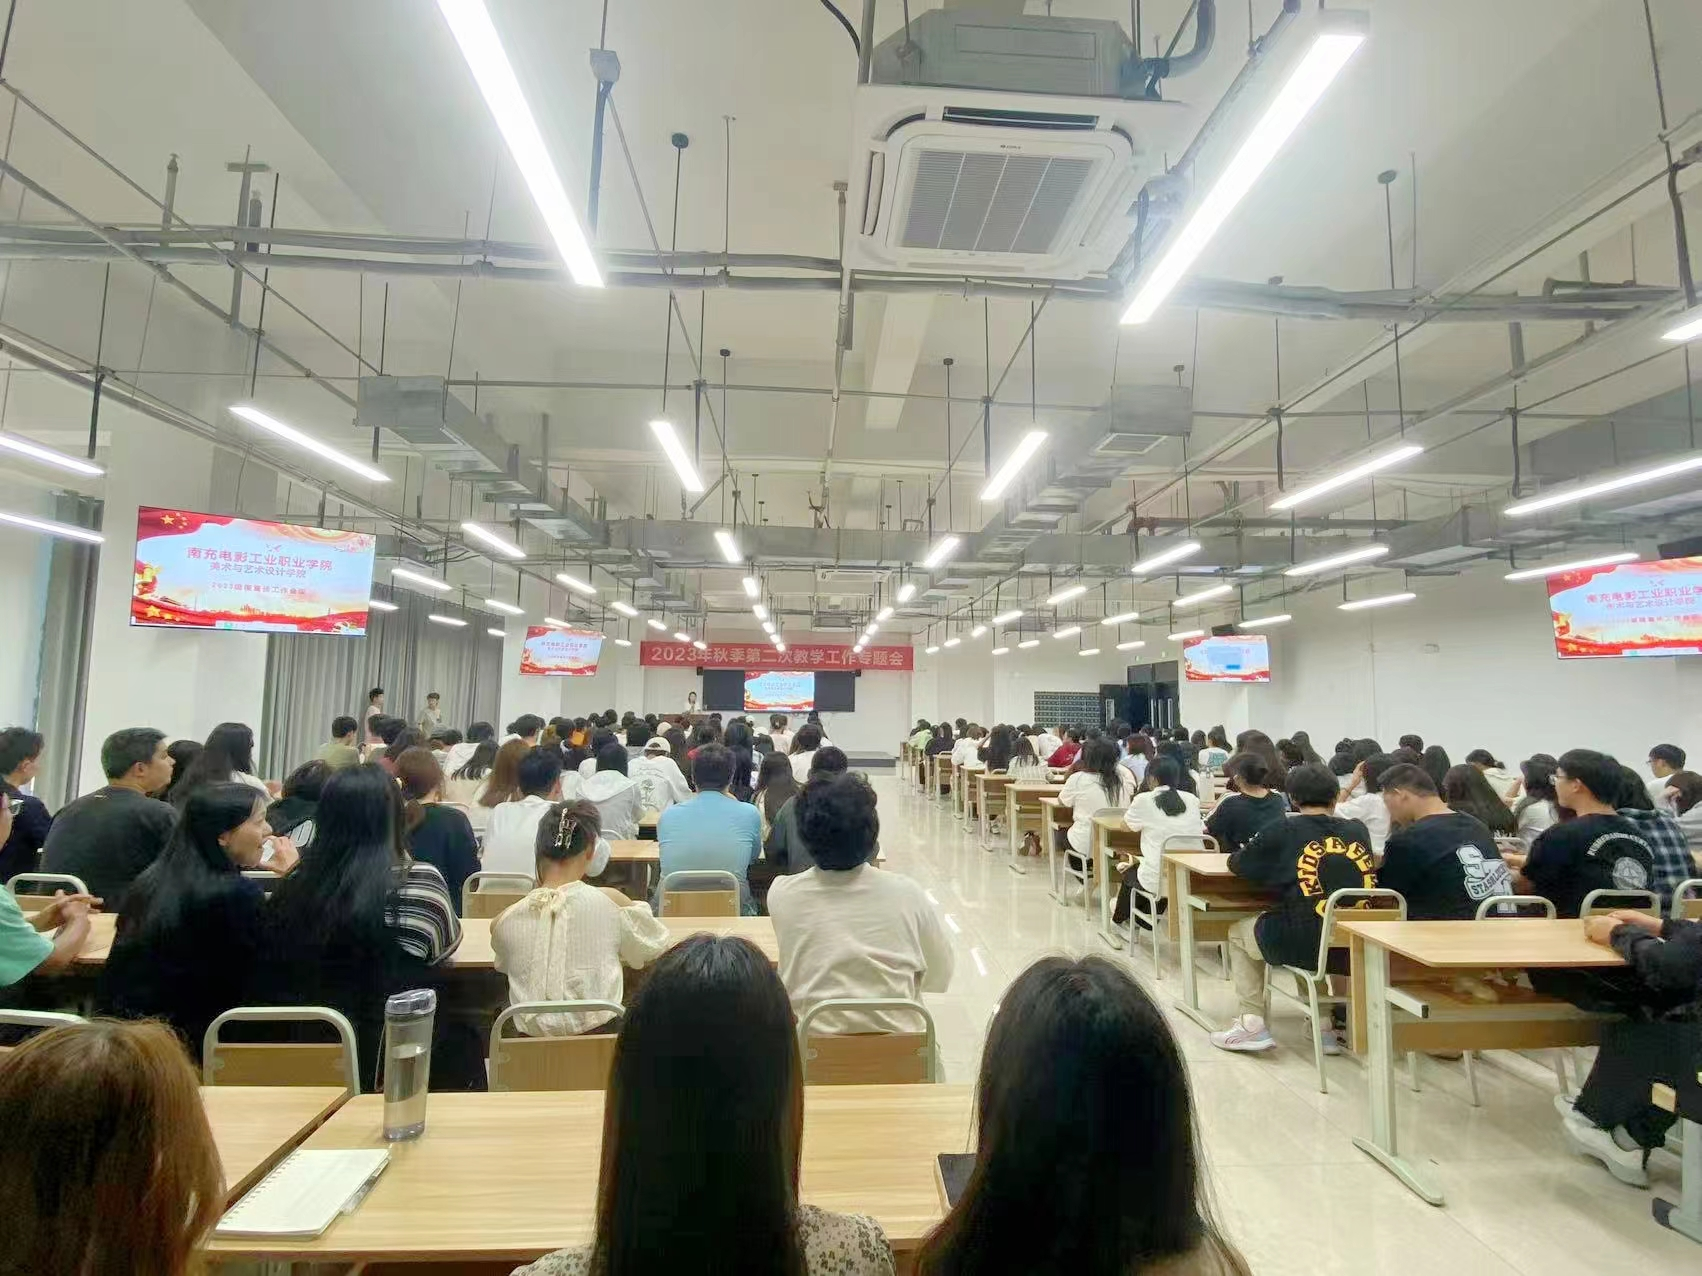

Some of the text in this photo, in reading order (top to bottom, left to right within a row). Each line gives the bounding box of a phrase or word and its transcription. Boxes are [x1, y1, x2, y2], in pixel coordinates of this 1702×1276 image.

[187, 547, 333, 571] 南充电影工业职业学院
[210, 562, 306, 579] 美术与艺术设计学院
[651, 647, 904, 666] 2023年秋季第二次教学工作专题会
